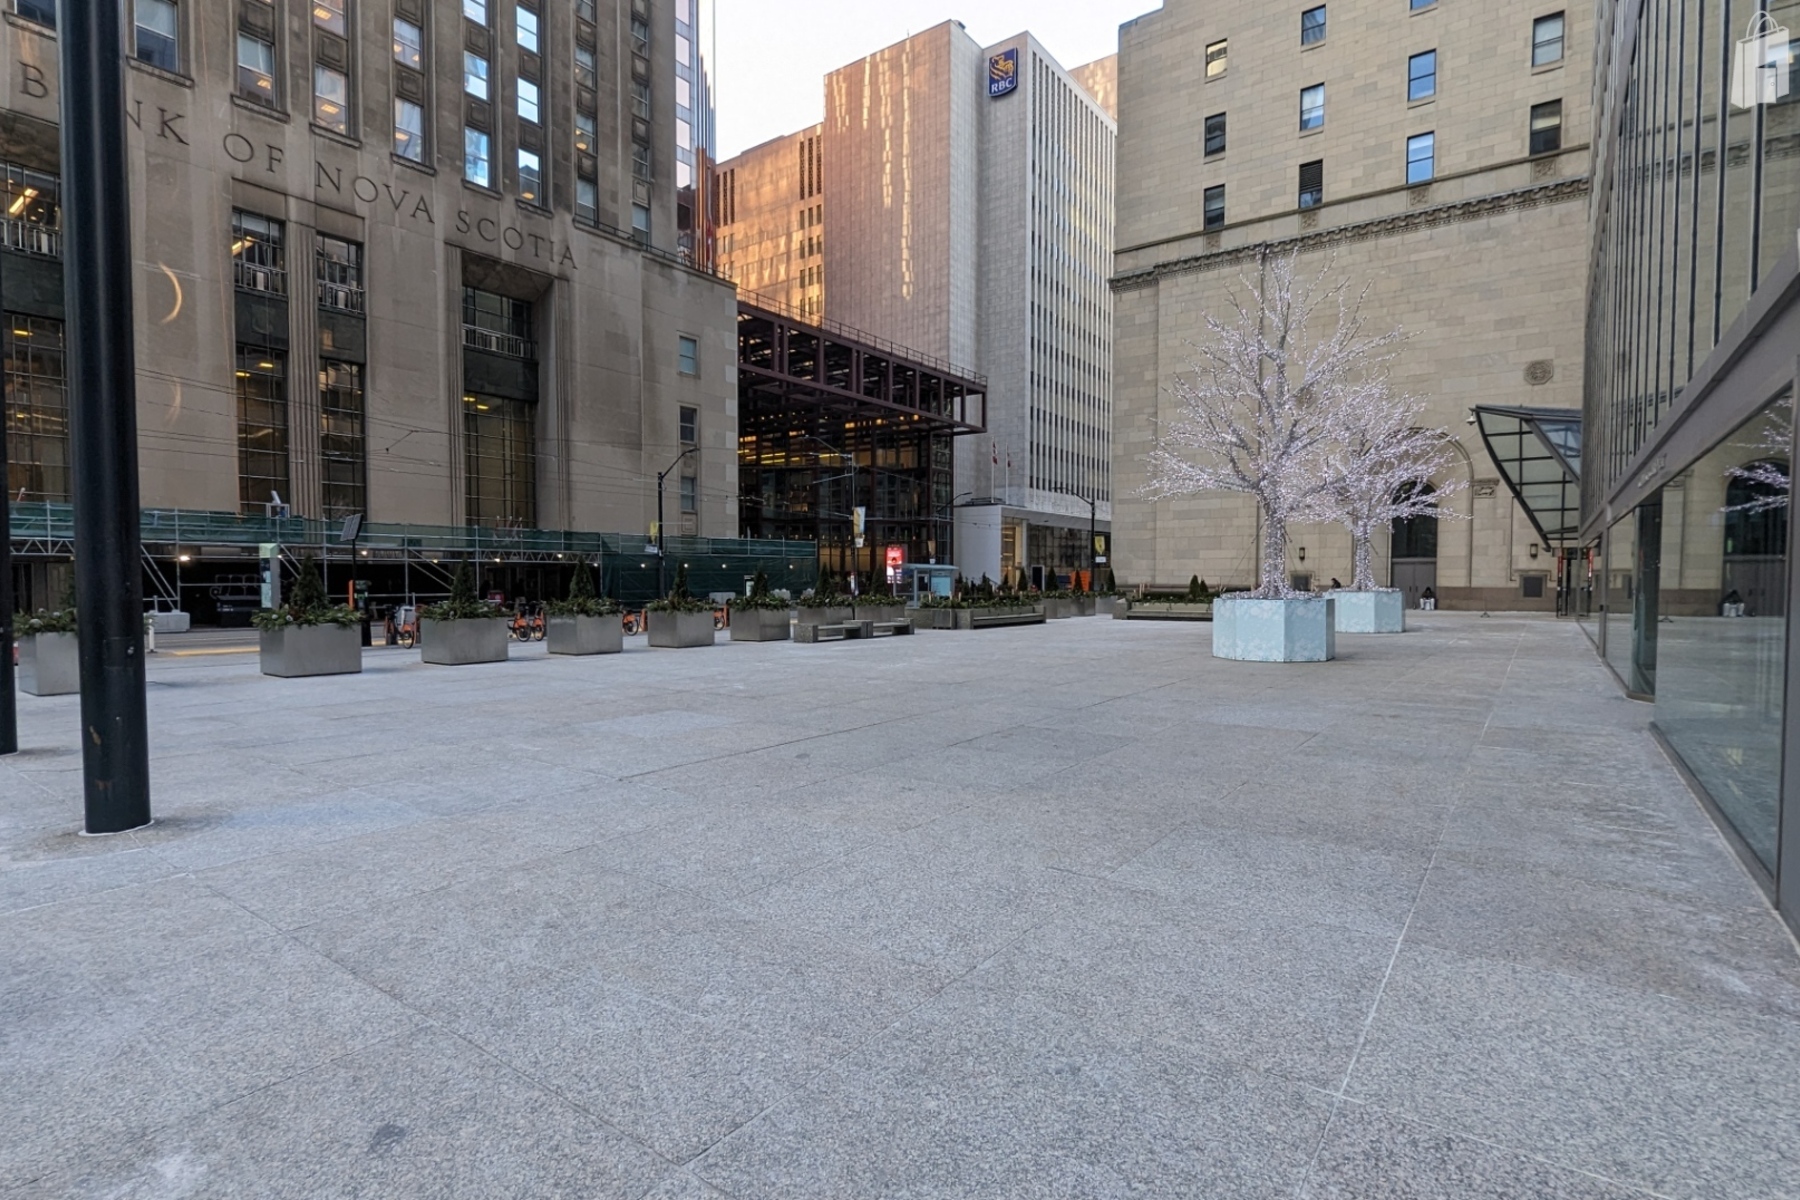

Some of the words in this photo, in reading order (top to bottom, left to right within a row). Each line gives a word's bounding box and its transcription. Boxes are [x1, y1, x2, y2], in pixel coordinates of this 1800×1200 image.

[991, 78, 1012, 93] RBC
[18, 61, 190, 146] BNK
[223, 133, 284, 173] OF
[315, 161, 435, 224] NOVA
[455, 210, 578, 270] SCOTIA
